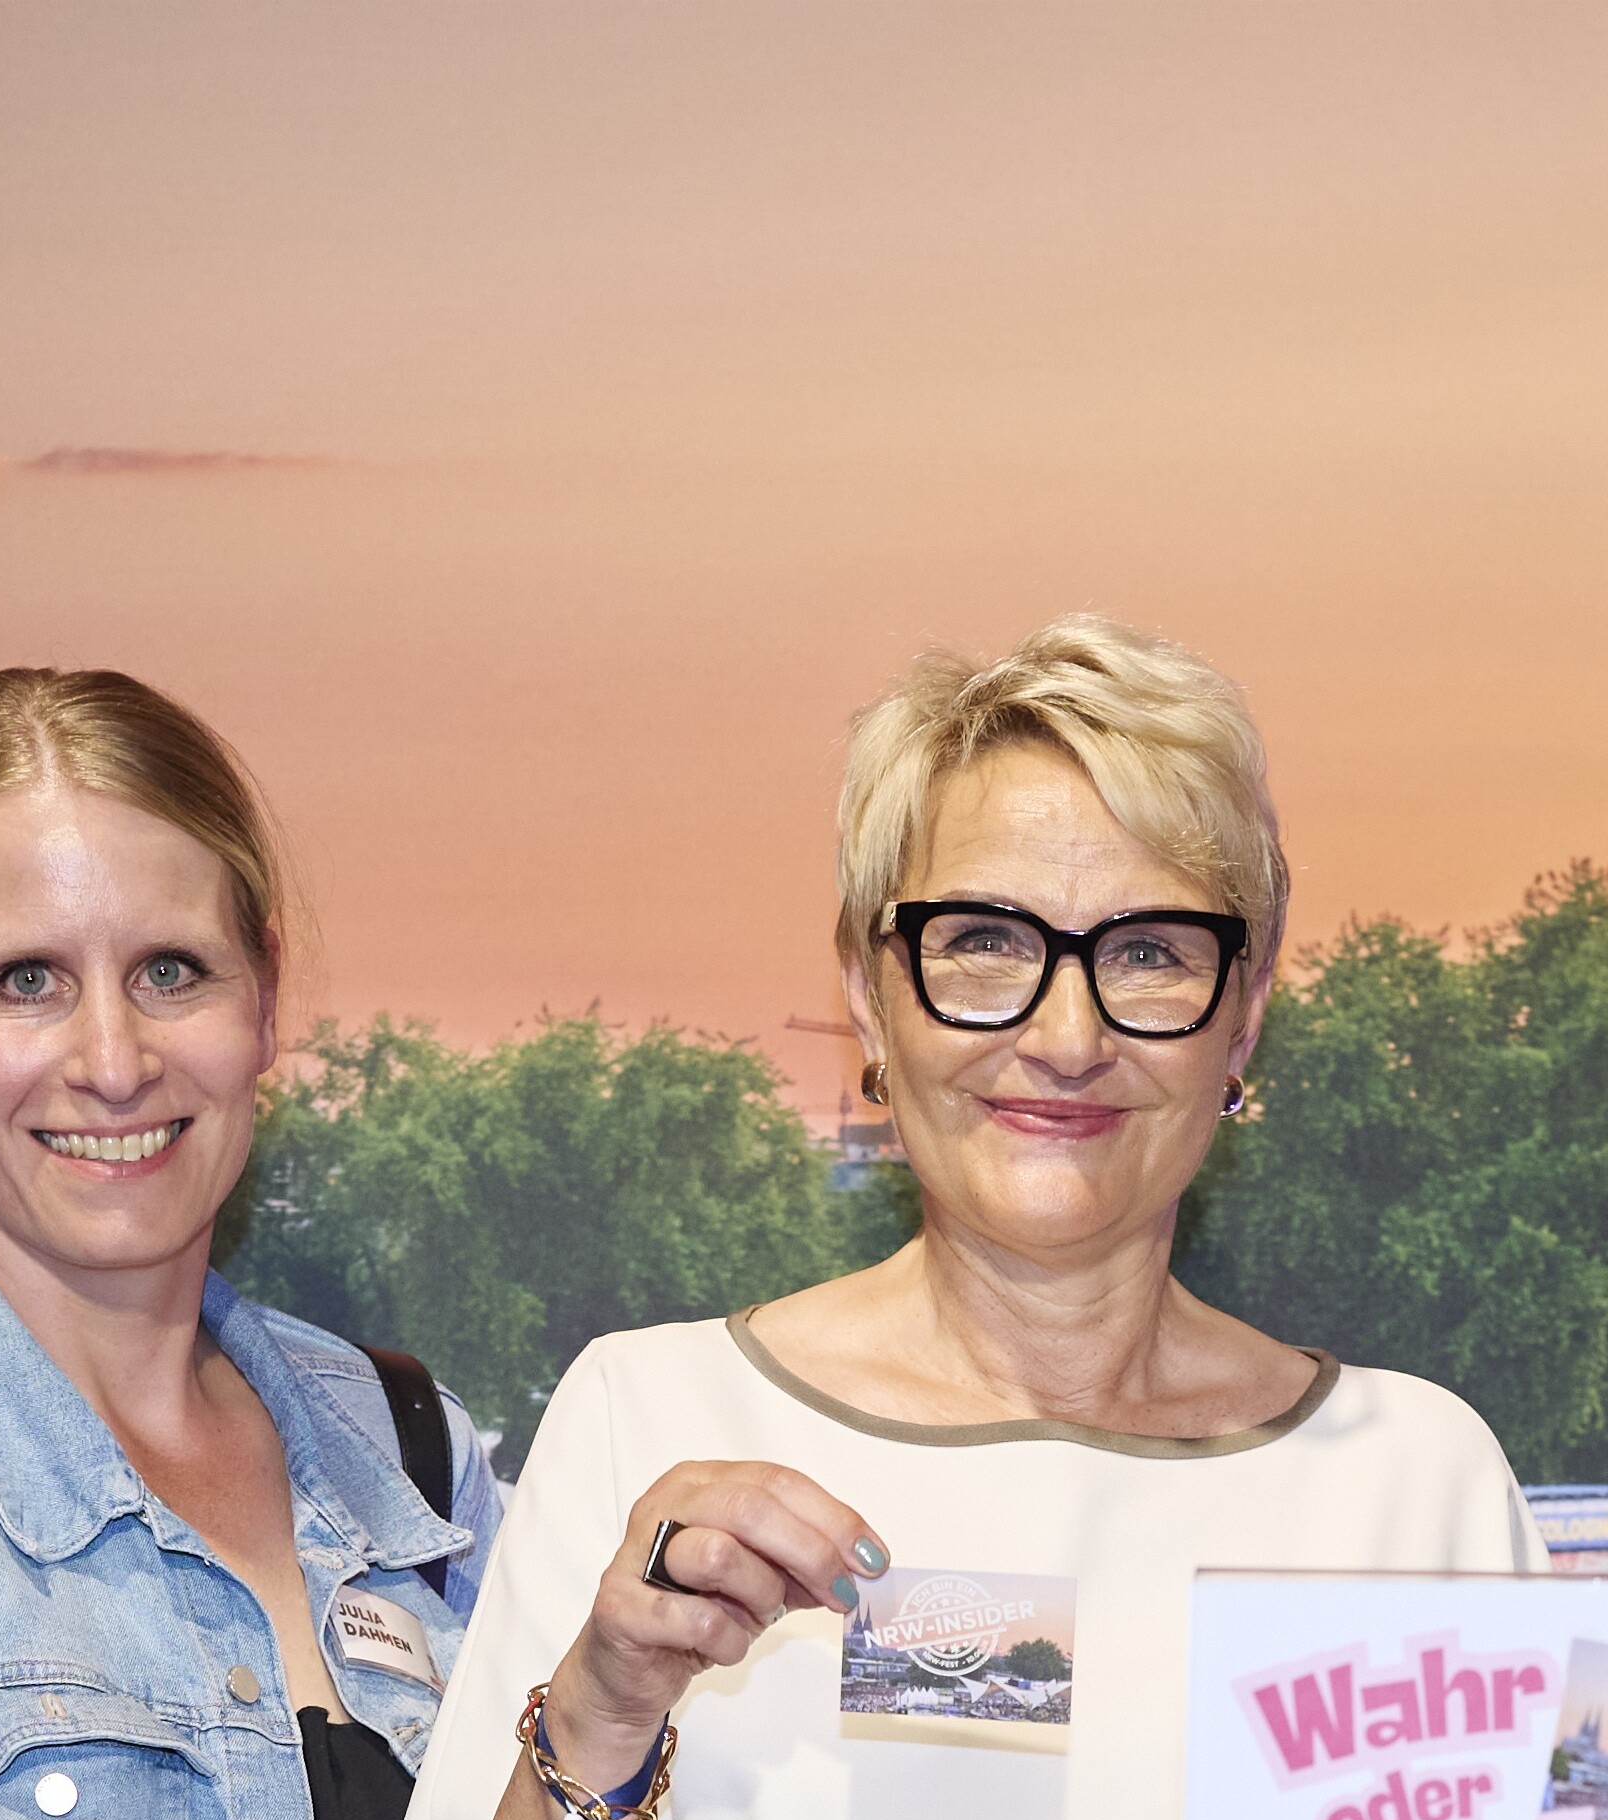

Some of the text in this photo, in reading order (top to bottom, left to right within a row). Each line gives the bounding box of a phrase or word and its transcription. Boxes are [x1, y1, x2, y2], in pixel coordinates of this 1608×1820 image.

[914, 1590, 930, 1607] ICH
[933, 1581, 951, 1593] BIN
[339, 1604, 385, 1628] JULIA
[863, 1600, 1036, 1649] NRW-INSIDER
[344, 1622, 413, 1655] DAHMEN
[1254, 1648, 1546, 1773] Wahr
